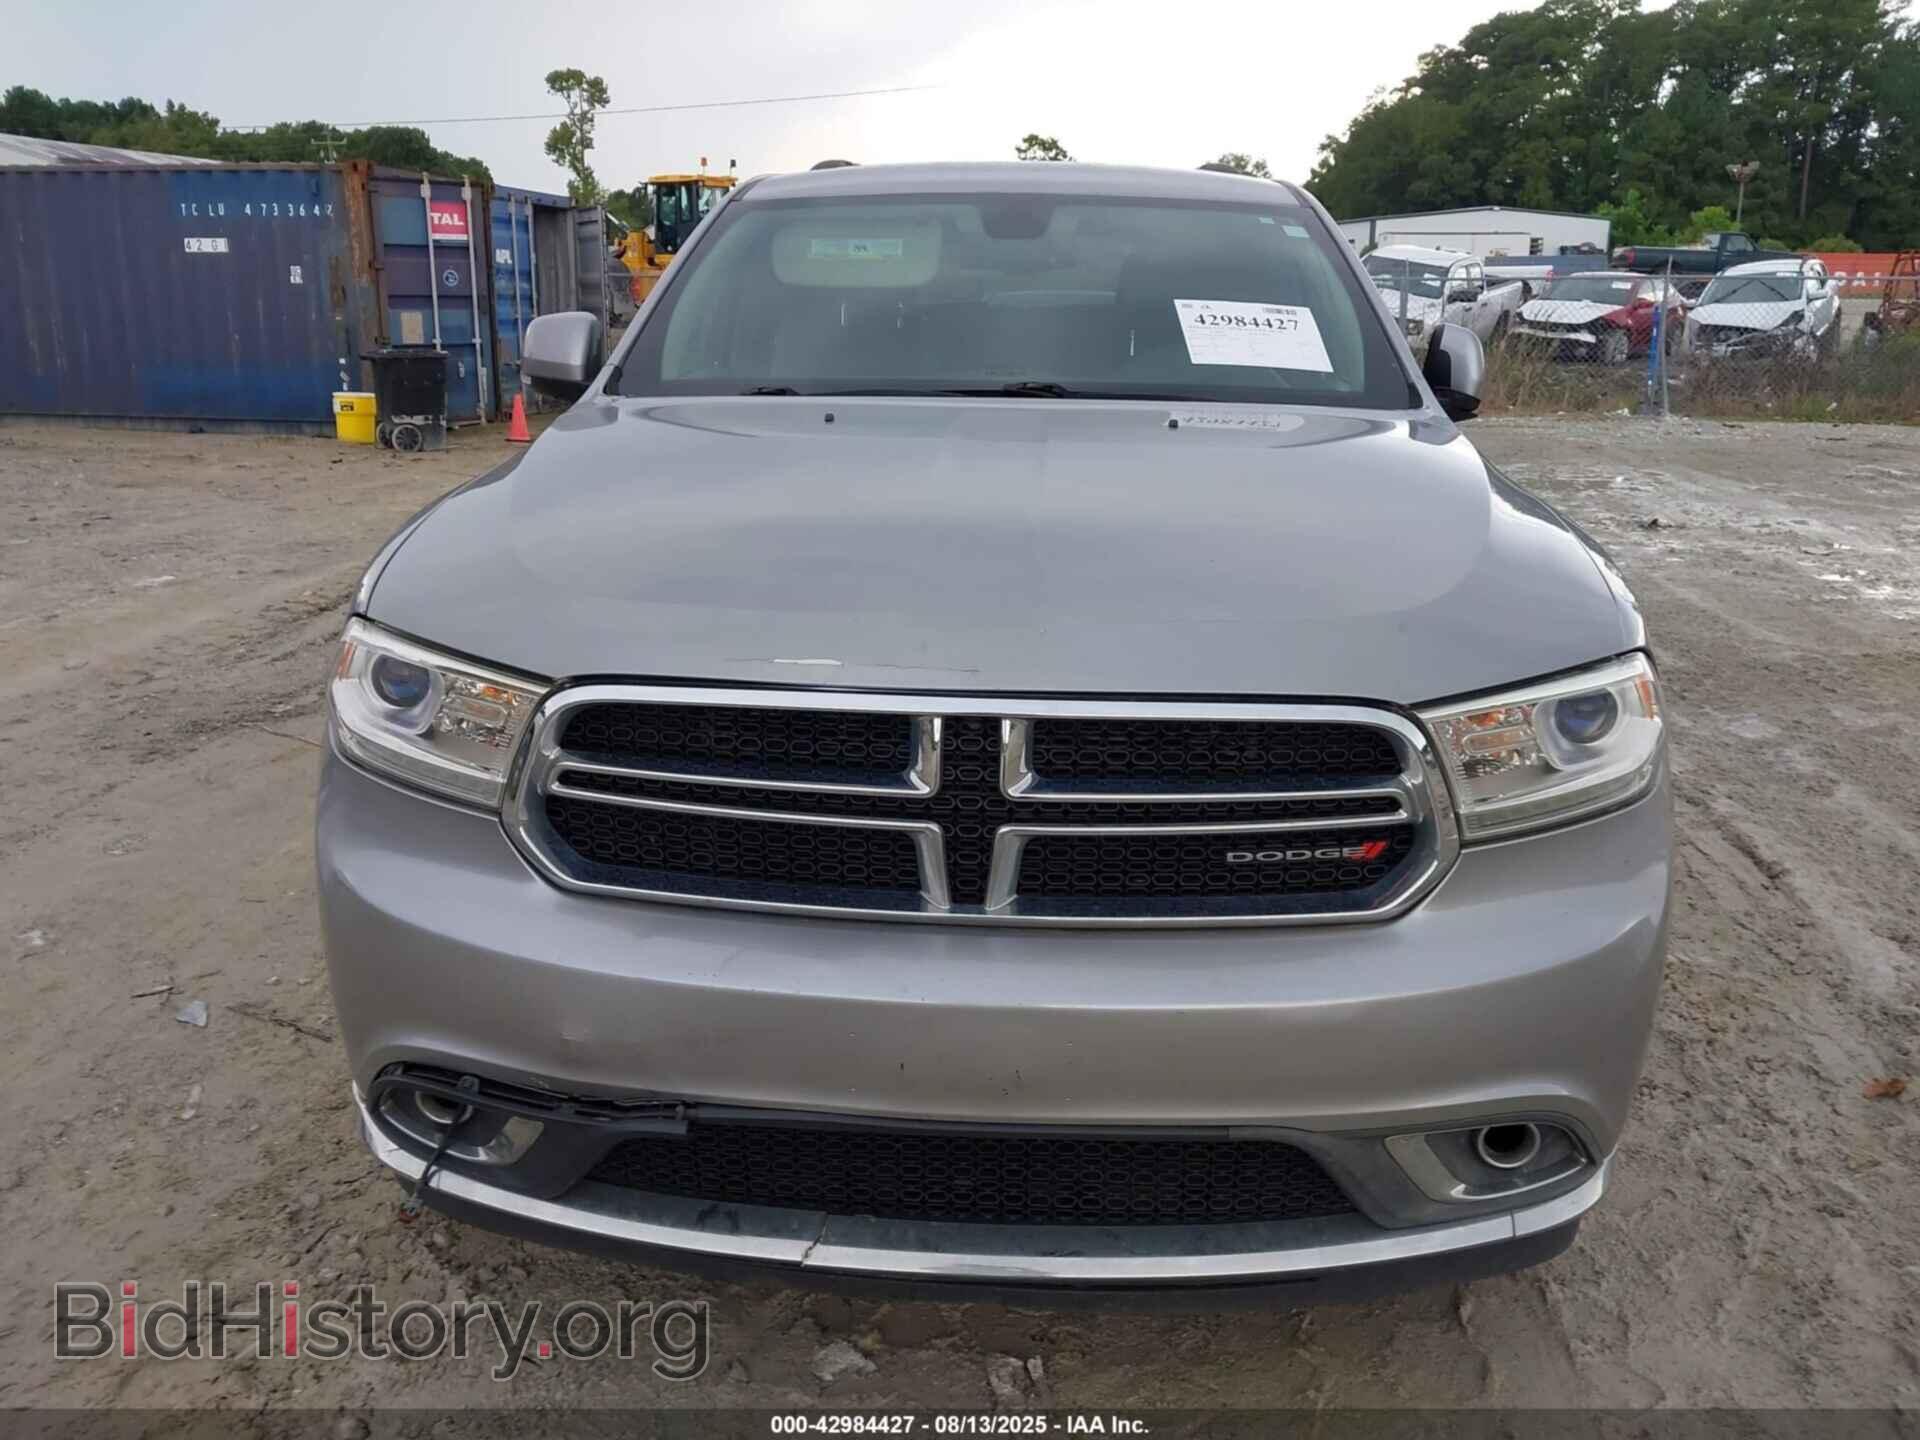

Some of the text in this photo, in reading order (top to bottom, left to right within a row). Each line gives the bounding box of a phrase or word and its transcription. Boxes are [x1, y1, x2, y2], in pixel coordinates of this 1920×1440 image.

[430, 212, 465, 226] TAL
[1194, 313, 1299, 330] 42984427
[1227, 847, 1366, 863] DODGE
